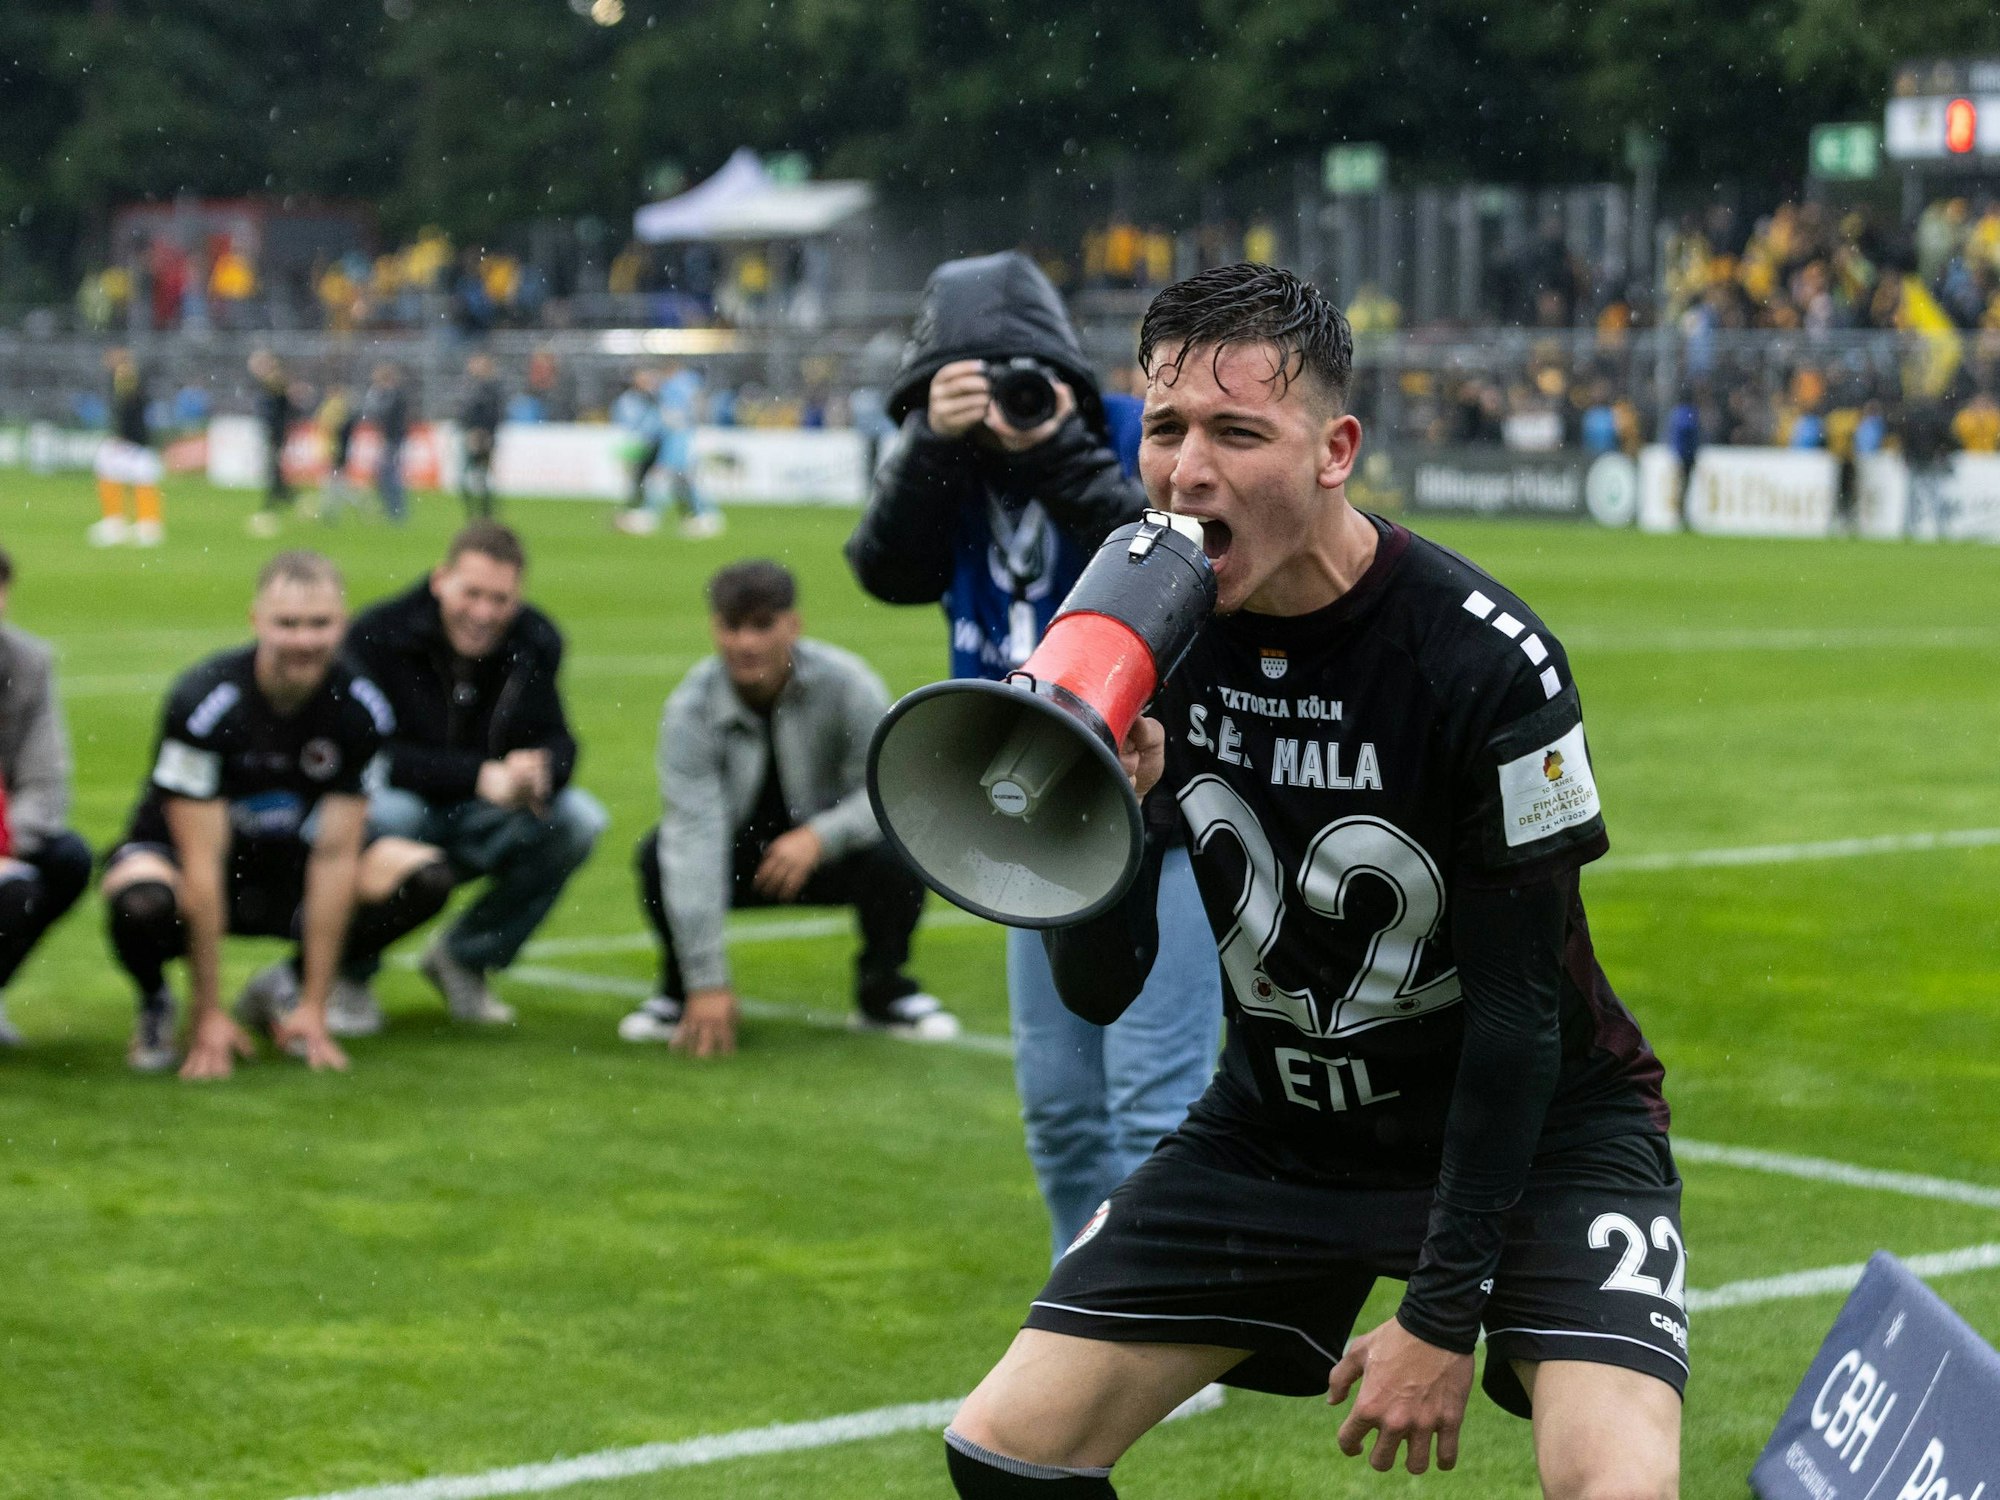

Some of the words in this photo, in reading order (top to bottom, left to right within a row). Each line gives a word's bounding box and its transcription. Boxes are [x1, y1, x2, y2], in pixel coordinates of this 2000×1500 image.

[1217, 685, 1290, 718] IKTORIA
[1297, 694, 1343, 720] KÖLN
[1271, 737, 1383, 790] MALA
[1519, 812, 1542, 826] DER
[1533, 784, 1584, 812] FINALTAG
[1541, 824, 1552, 832] 24.
[1568, 809, 1587, 821] 2025
[1176, 773, 1463, 1038] 22
[1275, 1047, 1400, 1112] ETL
[1588, 1212, 1686, 1312] 22
[1811, 1349, 1898, 1474] CBH
